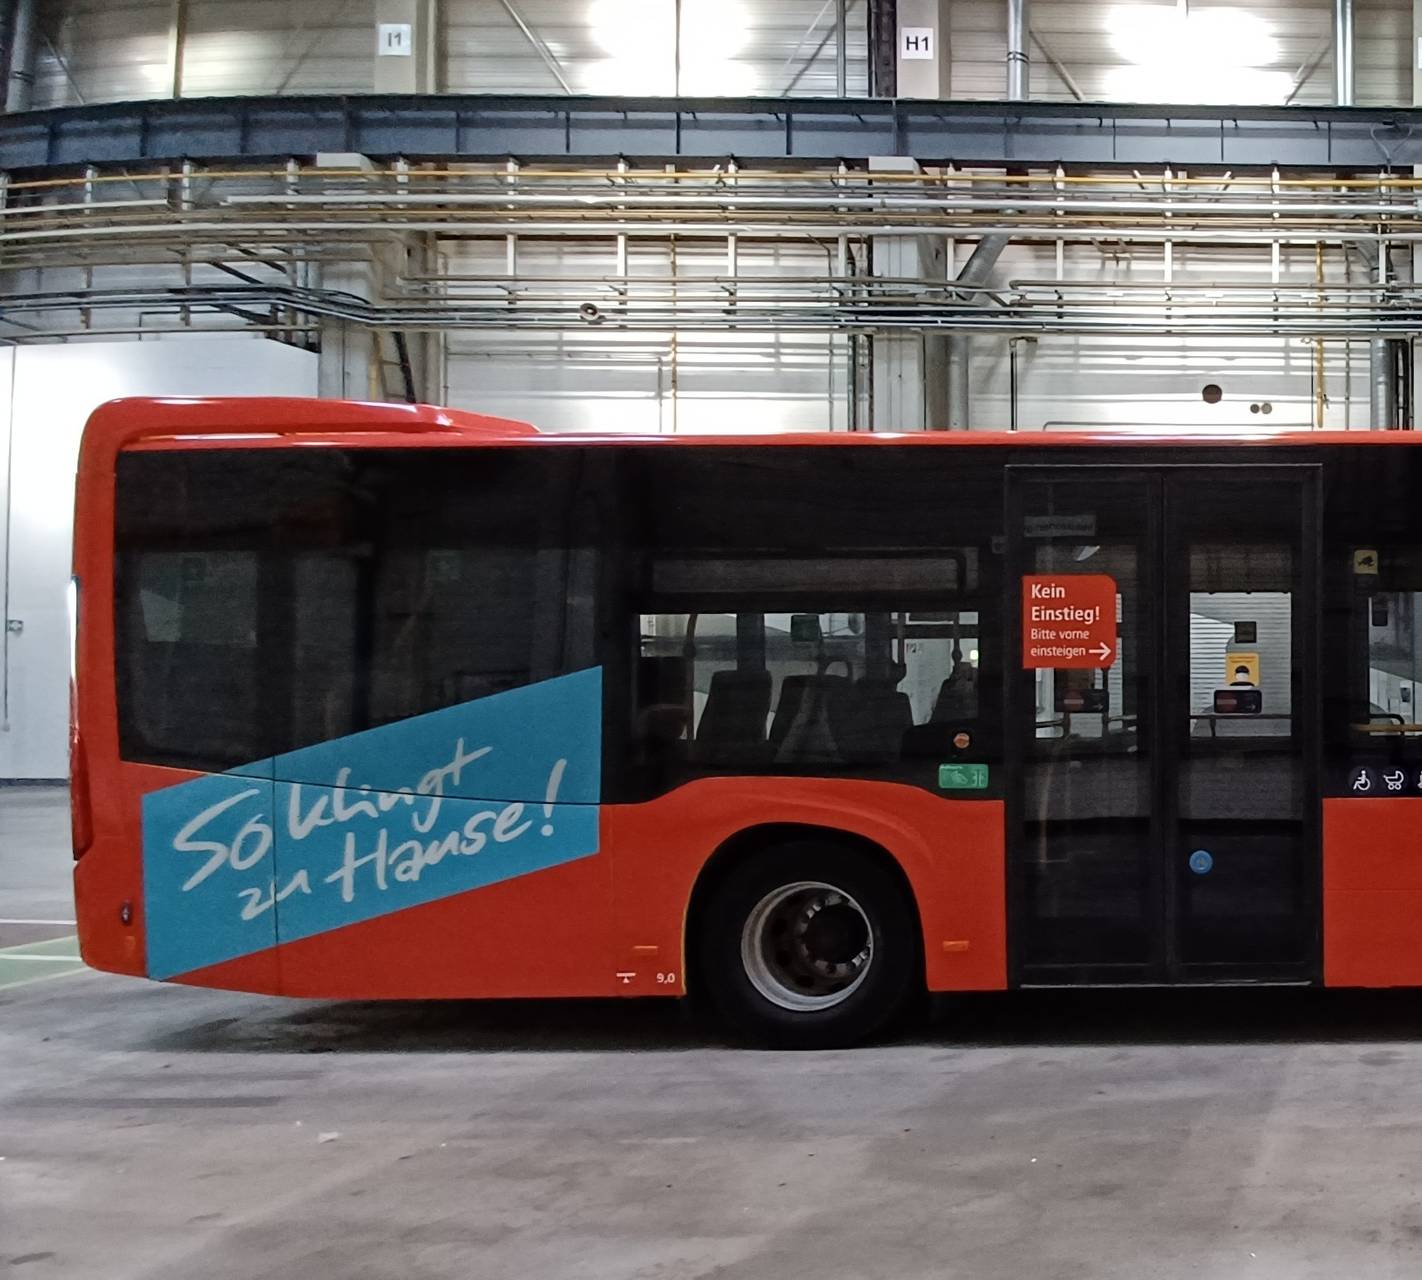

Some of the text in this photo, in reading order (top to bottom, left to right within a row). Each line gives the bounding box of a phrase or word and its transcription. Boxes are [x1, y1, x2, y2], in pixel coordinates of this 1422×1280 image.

[906, 36, 929, 51] H1
[1031, 584, 1065, 598] Kein
[1031, 606, 1100, 625] Einstieg!
[1031, 628, 1090, 640] Bitte vorne
[1030, 645, 1086, 659] einsteigen
[173, 737, 493, 892] So klingt
[237, 758, 567, 921] zu Hause!
[656, 972, 676, 984] 9,0
